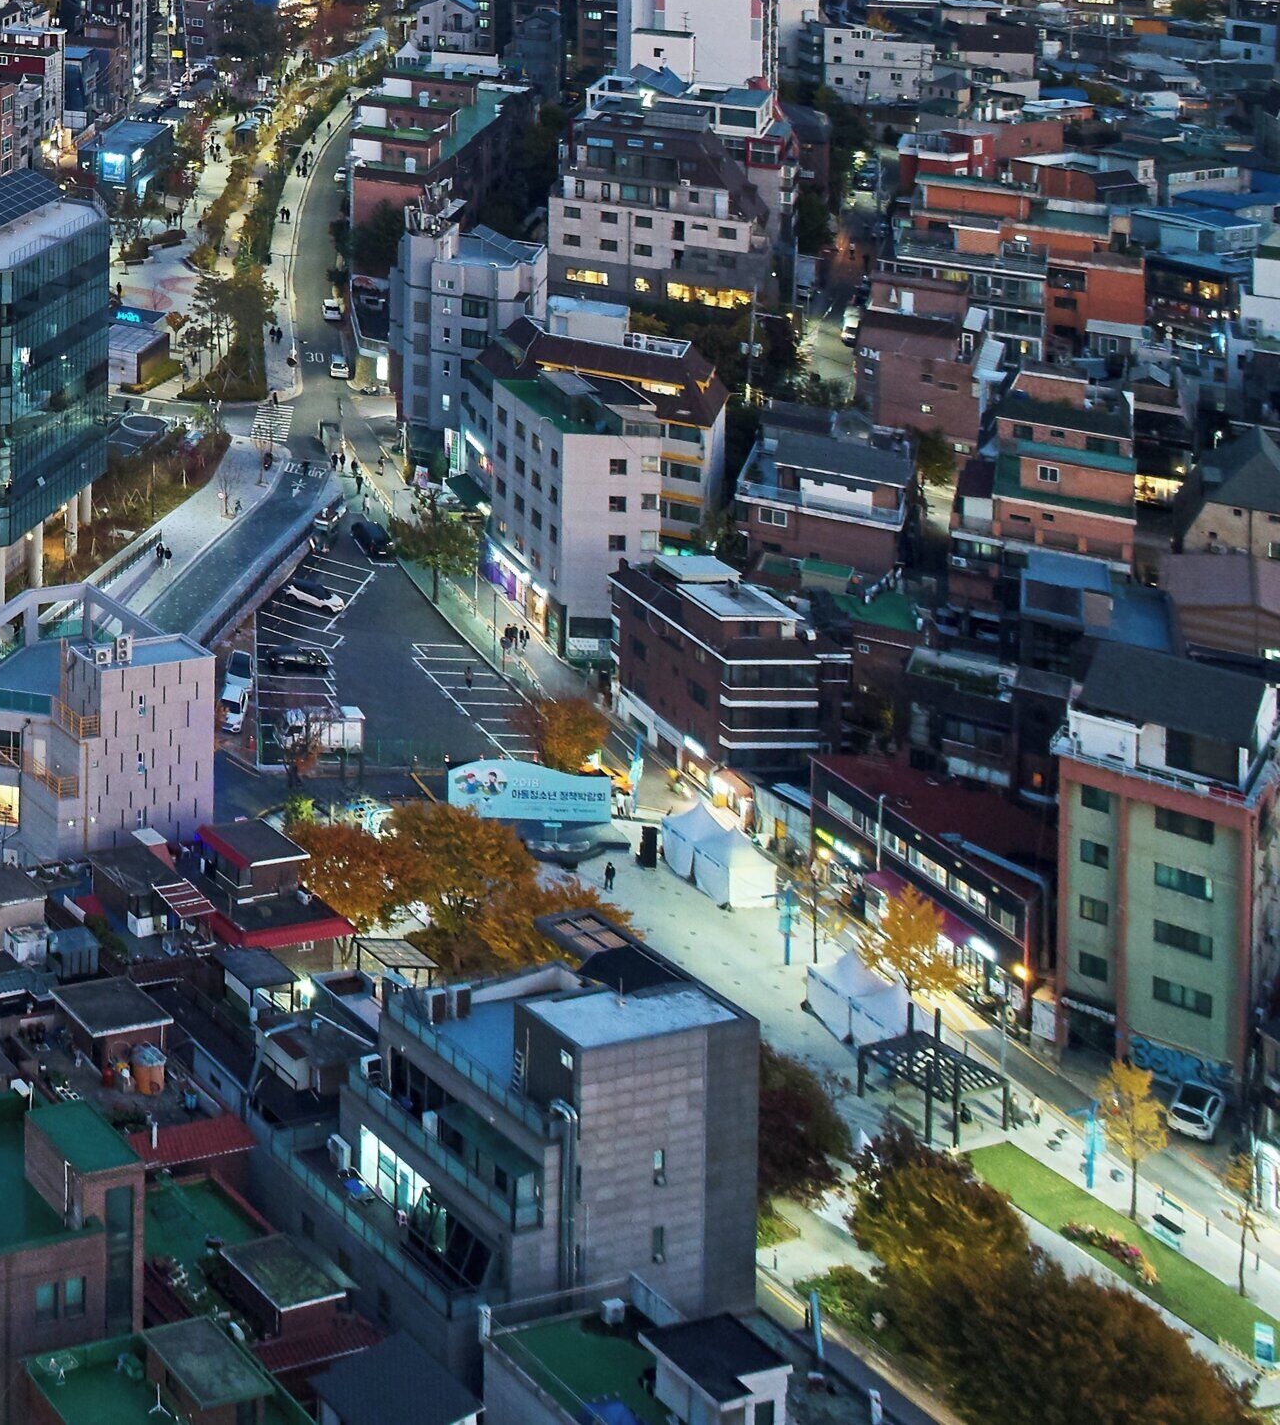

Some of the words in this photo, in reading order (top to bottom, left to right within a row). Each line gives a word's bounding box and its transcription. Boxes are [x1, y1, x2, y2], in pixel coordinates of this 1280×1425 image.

[305, 352, 324, 363] 30
[512, 778, 540, 789] 2018
[511, 789, 556, 802] 아동청소년
[559, 790, 606, 802] 정책박람회
